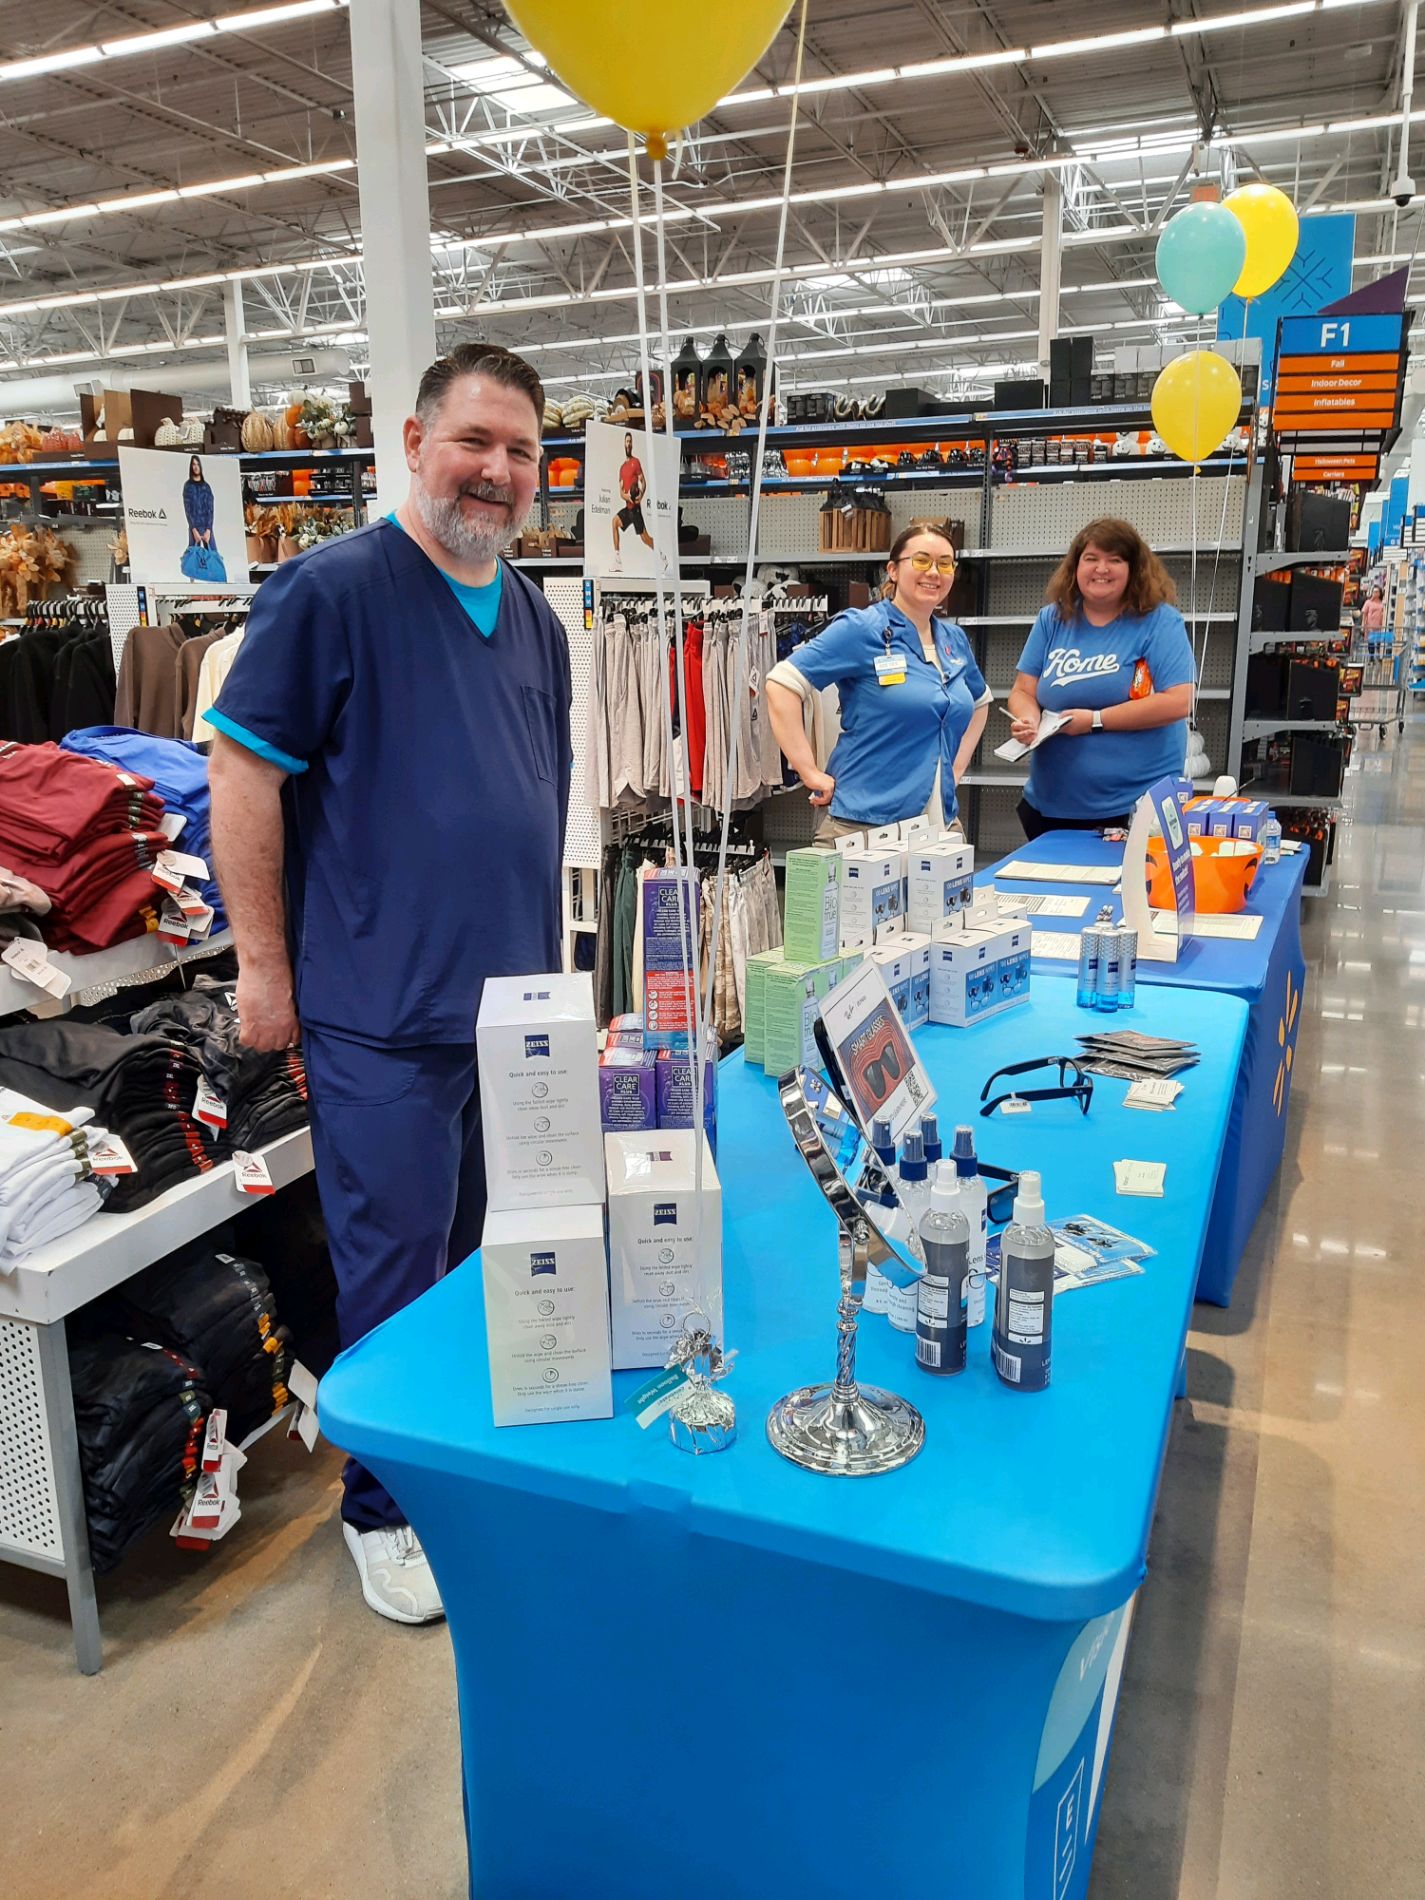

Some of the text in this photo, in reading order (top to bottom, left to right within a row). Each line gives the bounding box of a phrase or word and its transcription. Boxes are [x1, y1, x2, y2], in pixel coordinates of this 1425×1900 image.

[1320, 322, 1350, 348] F1
[1330, 360, 1345, 368] Fall
[1311, 378, 1362, 388] Indoor Decor
[1313, 398, 1356, 407] Inflatables
[646, 499, 668, 510] Rbok
[128, 508, 157, 519] Reebok
[1042, 648, 1120, 678] Home
[659, 888, 678, 896] CLEA
[163, 918, 189, 930] Reebok
[866, 1015, 886, 1040] GLASSES
[526, 1040, 549, 1048] ZEISS
[201, 1097, 224, 1110] Reebok
[241, 1171, 267, 1179] Reebok
[655, 1208, 677, 1216] ZEISS
[968, 1256, 984, 1265] Lens
[637, 1387, 659, 1404] Weight
[197, 1499, 220, 1507] Reebok
